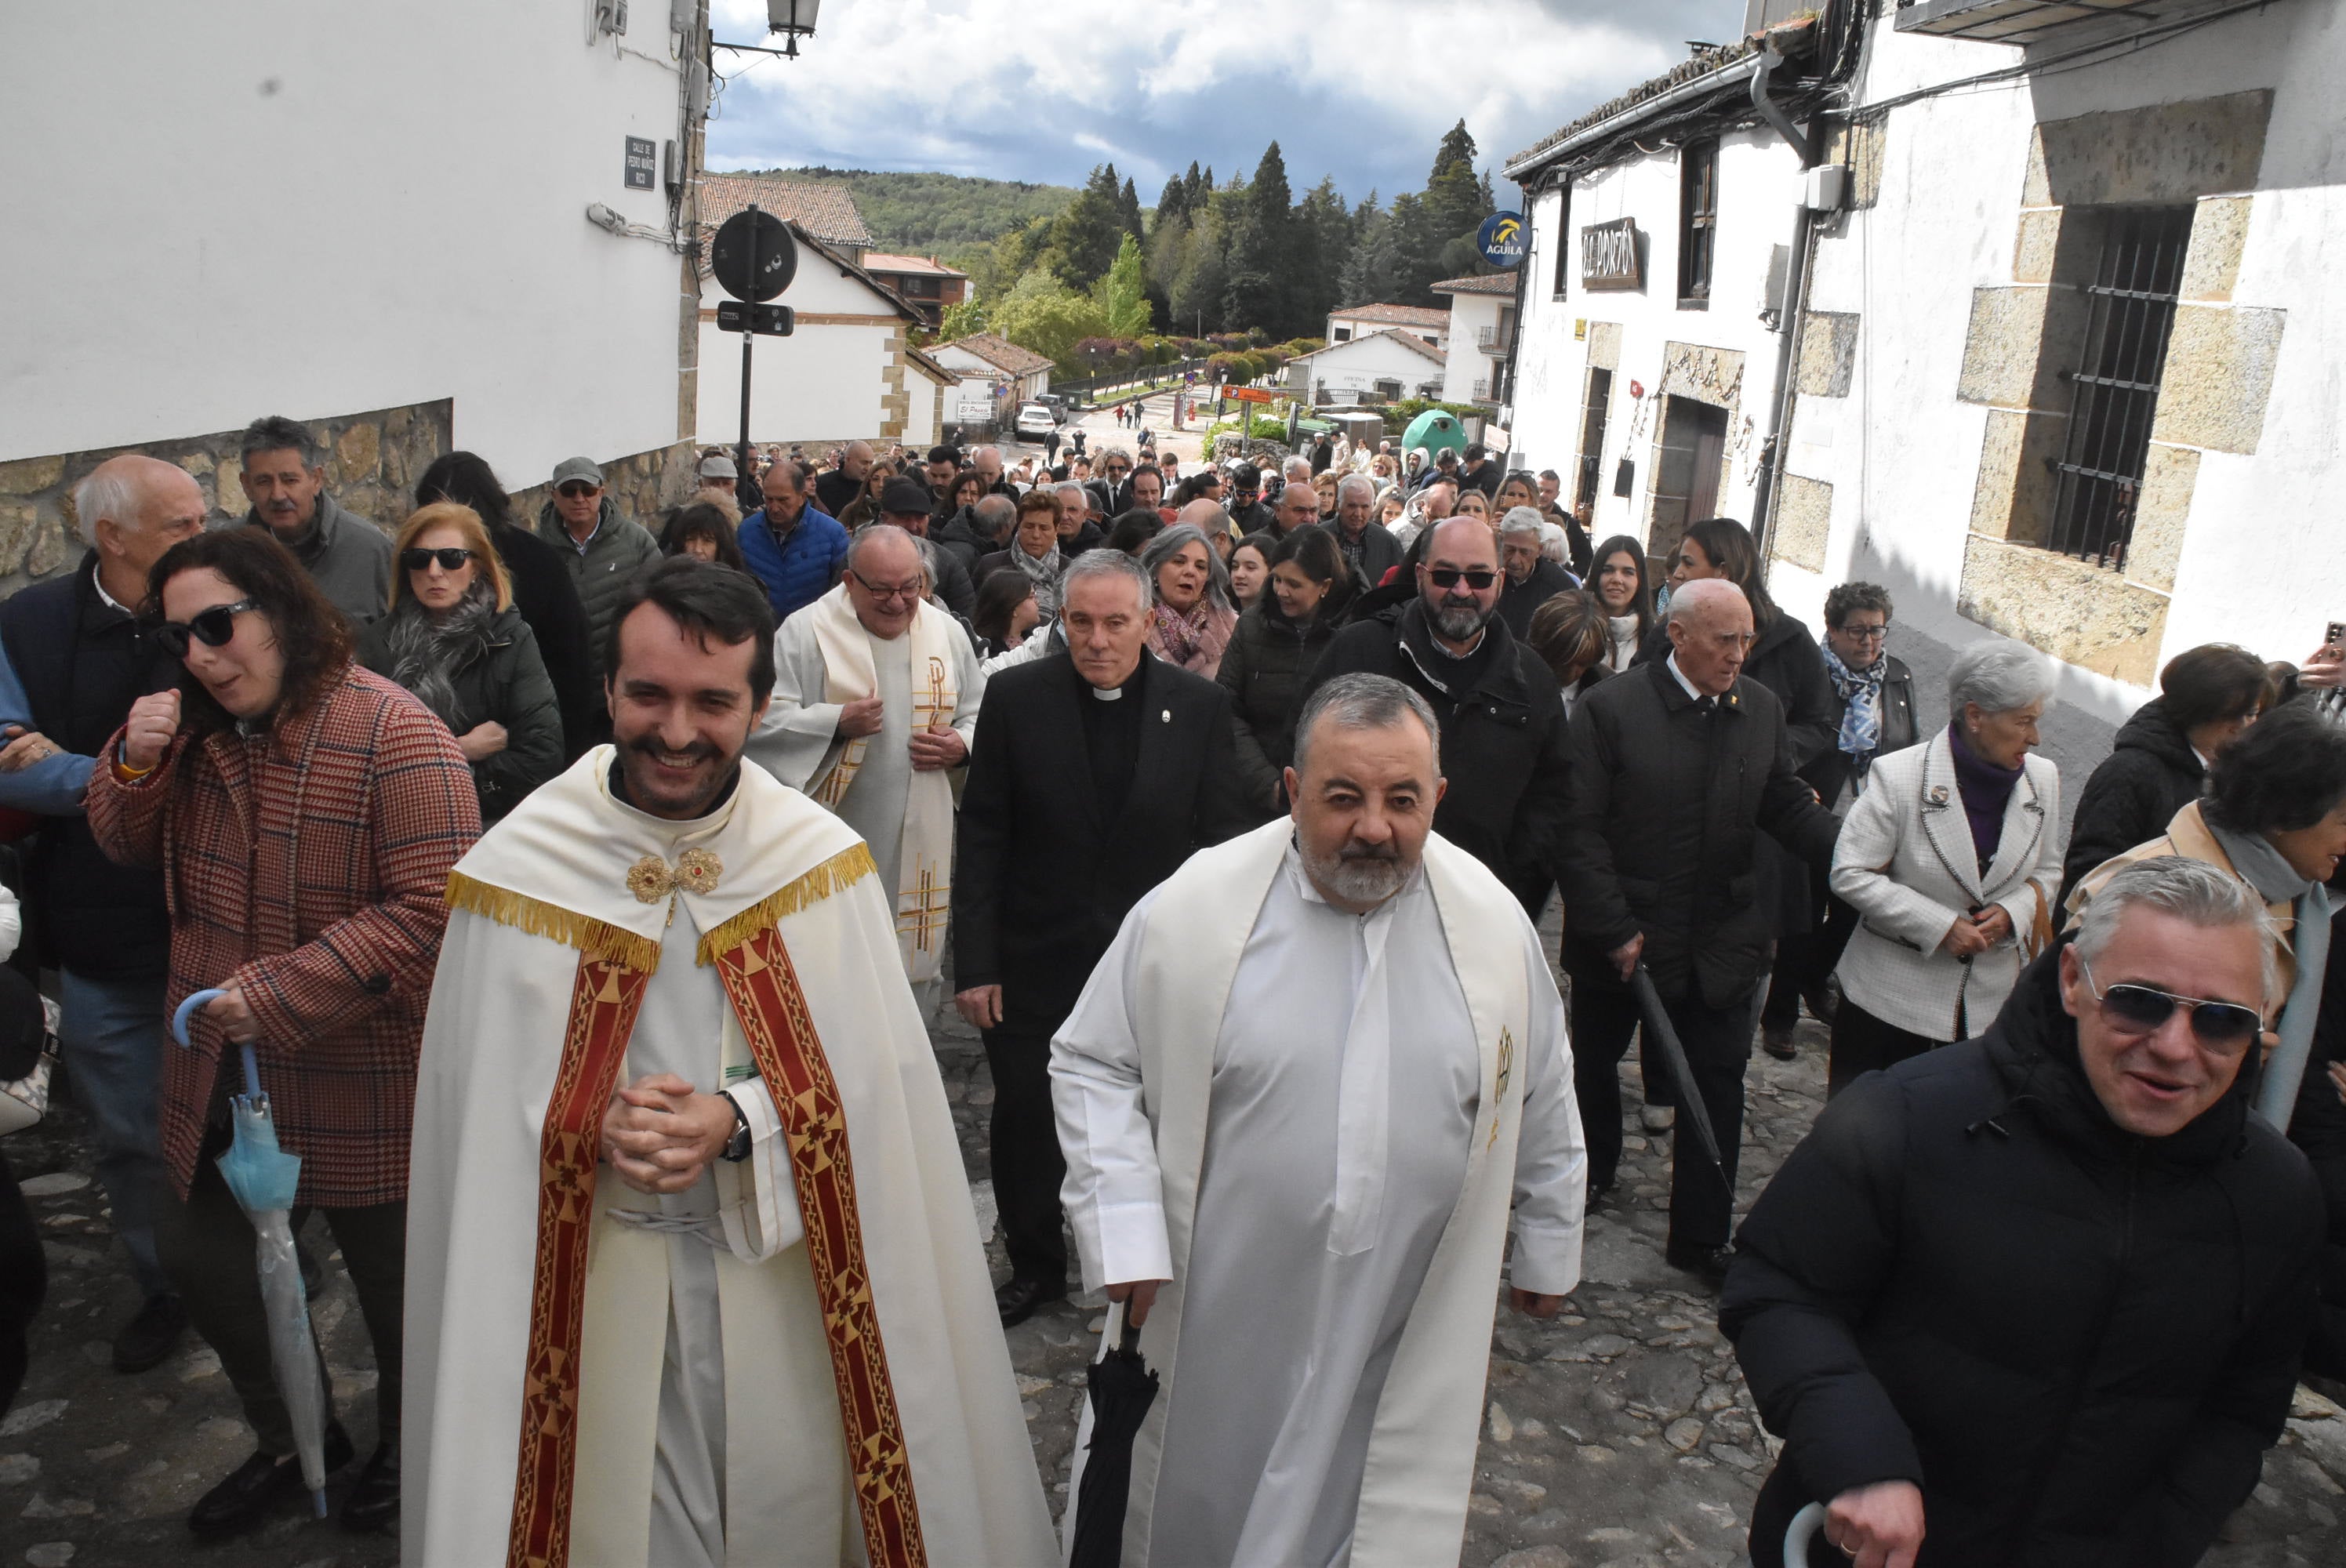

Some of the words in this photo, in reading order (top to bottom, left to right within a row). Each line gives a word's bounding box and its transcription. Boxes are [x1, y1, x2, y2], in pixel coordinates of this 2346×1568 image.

[634, 143, 644, 153] CALLE
[645, 145, 650, 154] DE
[629, 155, 641, 168] PEDRO
[641, 157, 654, 170] MUÑOZ
[636, 172, 645, 183] RICO
[1583, 234, 1593, 278] EL
